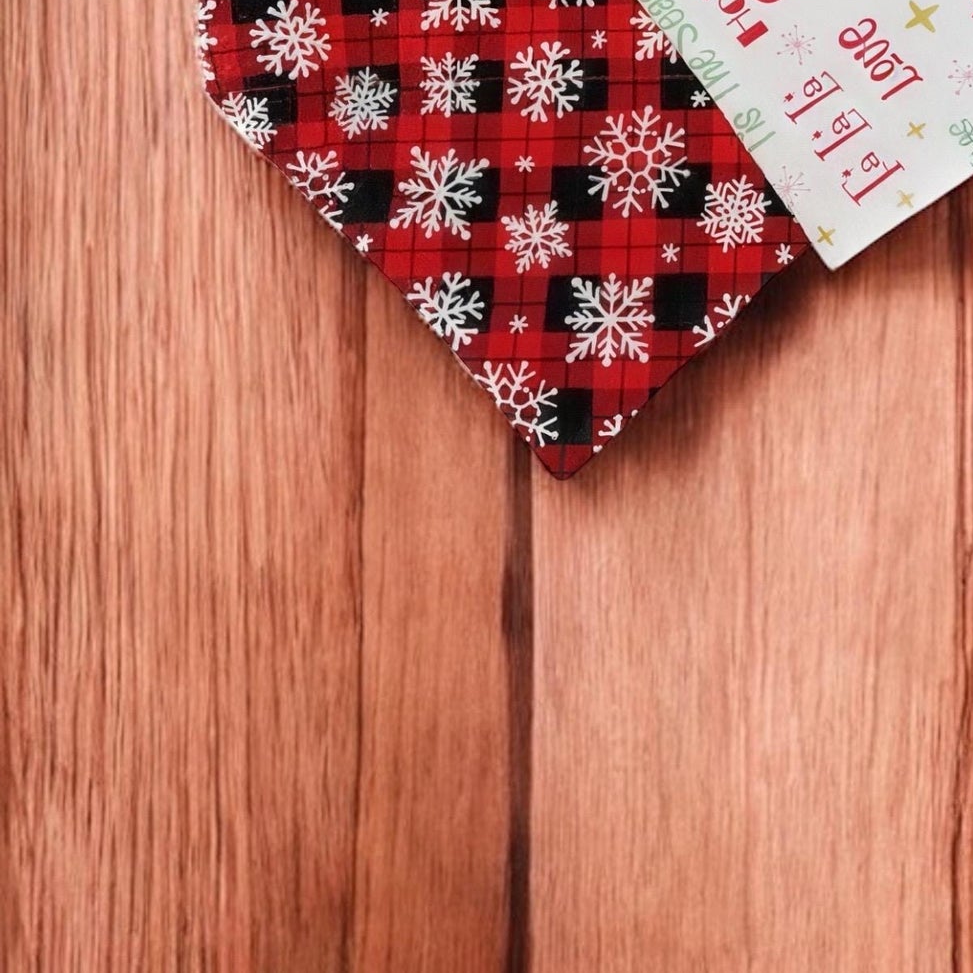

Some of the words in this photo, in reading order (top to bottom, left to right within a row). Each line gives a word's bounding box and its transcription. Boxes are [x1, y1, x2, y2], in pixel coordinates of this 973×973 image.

[838, 17, 923, 100] Love
[784, 70, 842, 123] La
[813, 108, 871, 161] La
[841, 151, 904, 205] Fa
